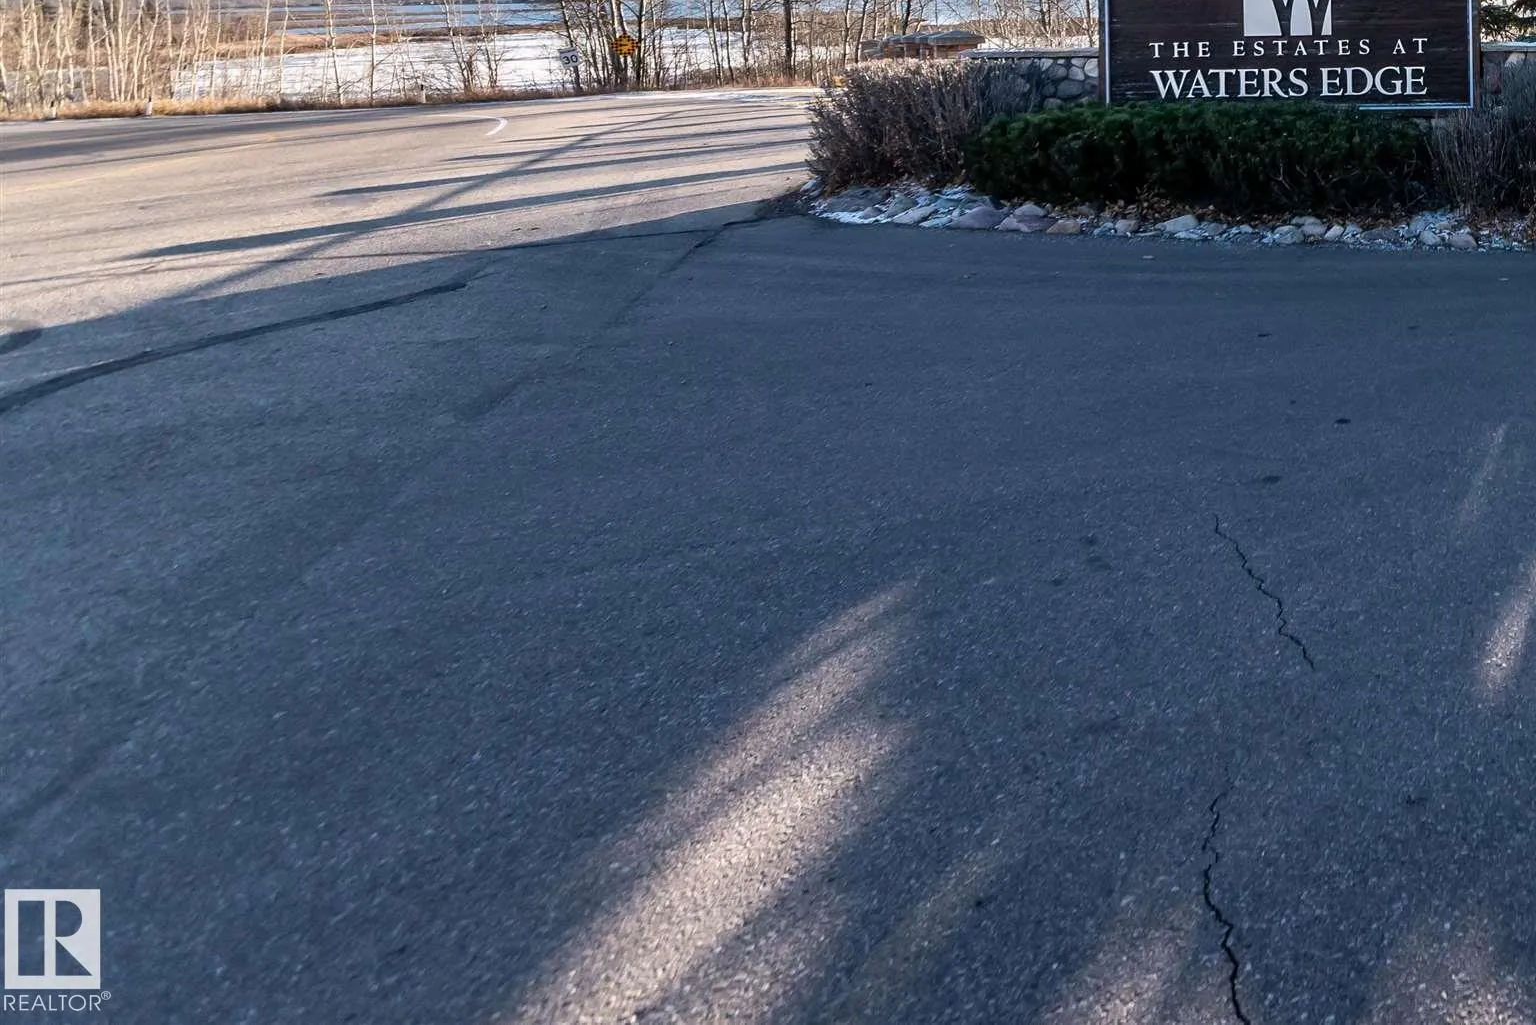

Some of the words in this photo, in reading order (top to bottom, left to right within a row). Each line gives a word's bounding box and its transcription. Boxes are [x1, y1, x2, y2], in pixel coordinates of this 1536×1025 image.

[1148, 41, 1211, 58] THE
[1232, 39, 1370, 56] ESTATES
[1392, 38, 1428, 55] AT
[562, 54, 578, 65] 30
[1149, 67, 1309, 99] WATERS
[1319, 65, 1427, 96] EDGE
